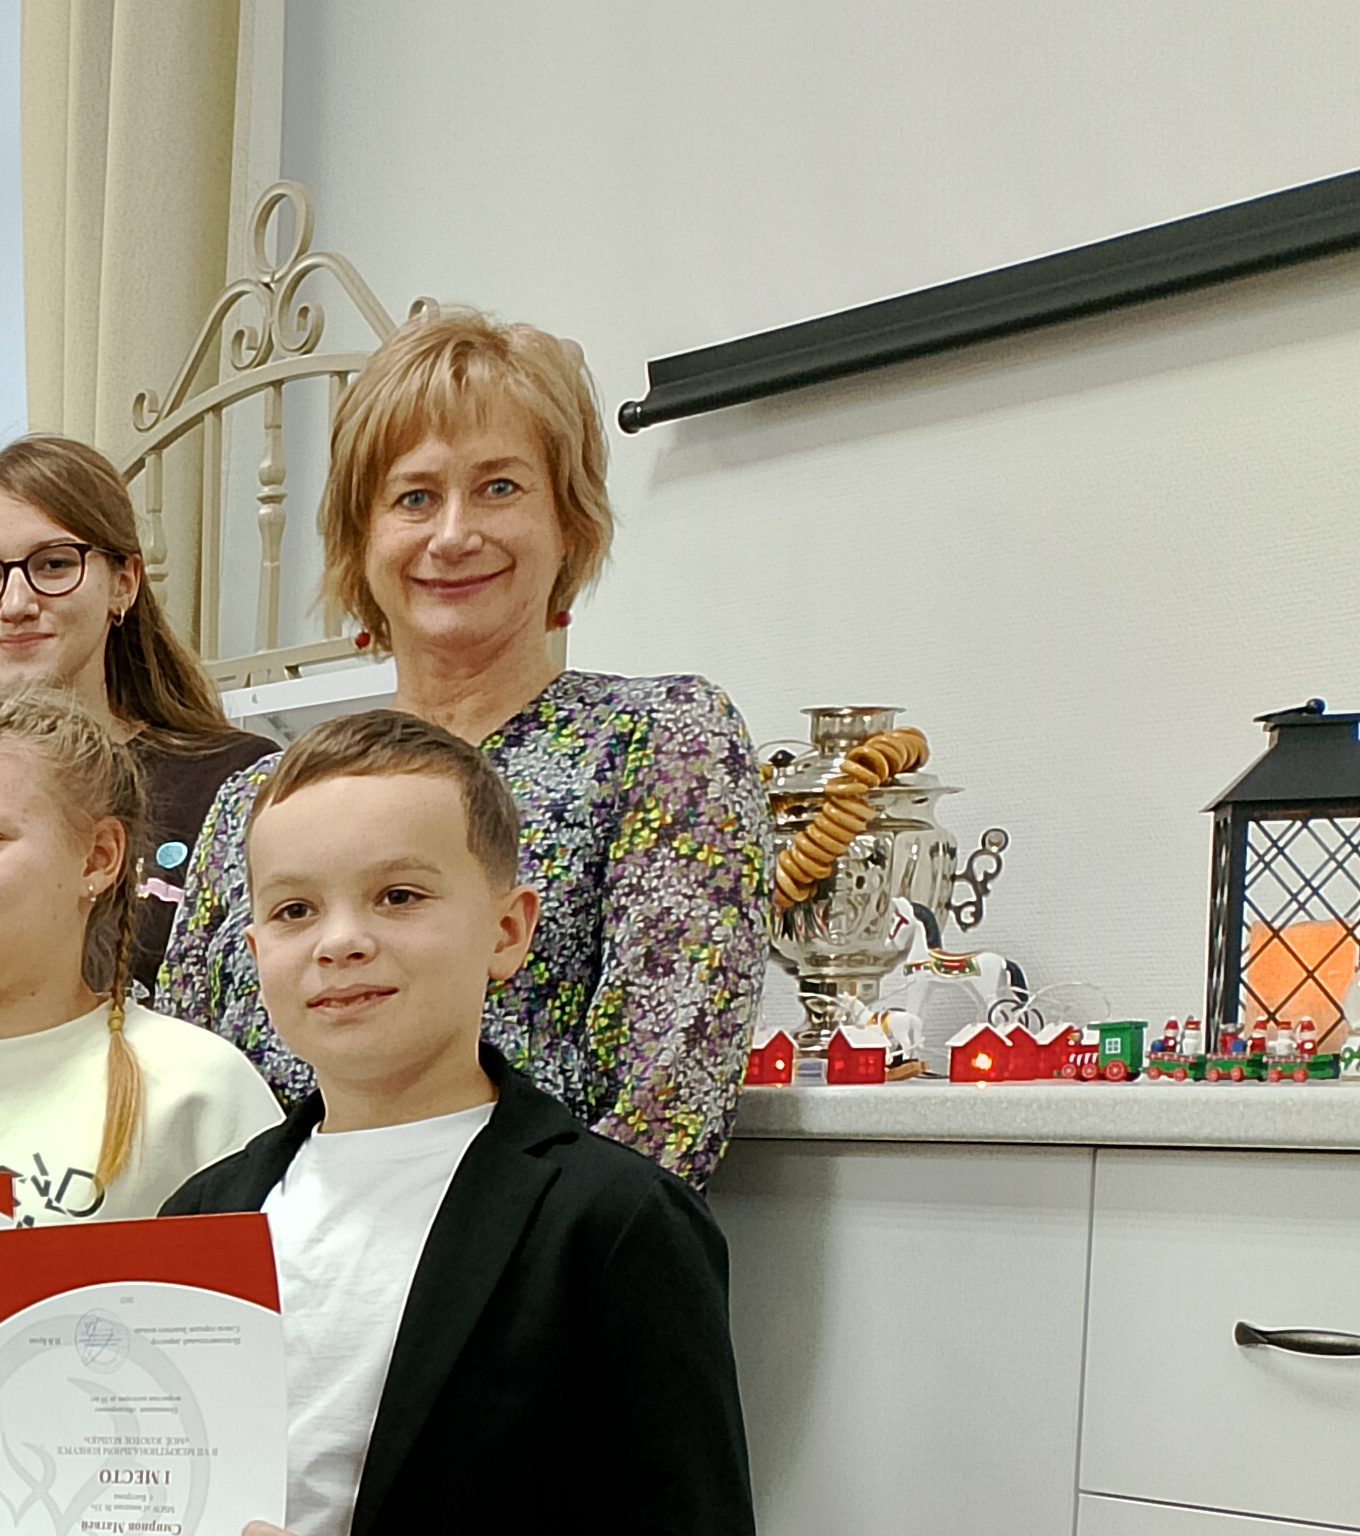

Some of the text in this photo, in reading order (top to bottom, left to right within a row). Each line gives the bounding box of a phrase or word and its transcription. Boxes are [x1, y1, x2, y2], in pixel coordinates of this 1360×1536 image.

[197, 1447, 210, 1457] VII
[212, 1448, 218, 1457] В
[99, 1469, 171, 1485] I МЕСТО
[81, 1519, 182, 1536] Смирнов Матвей
